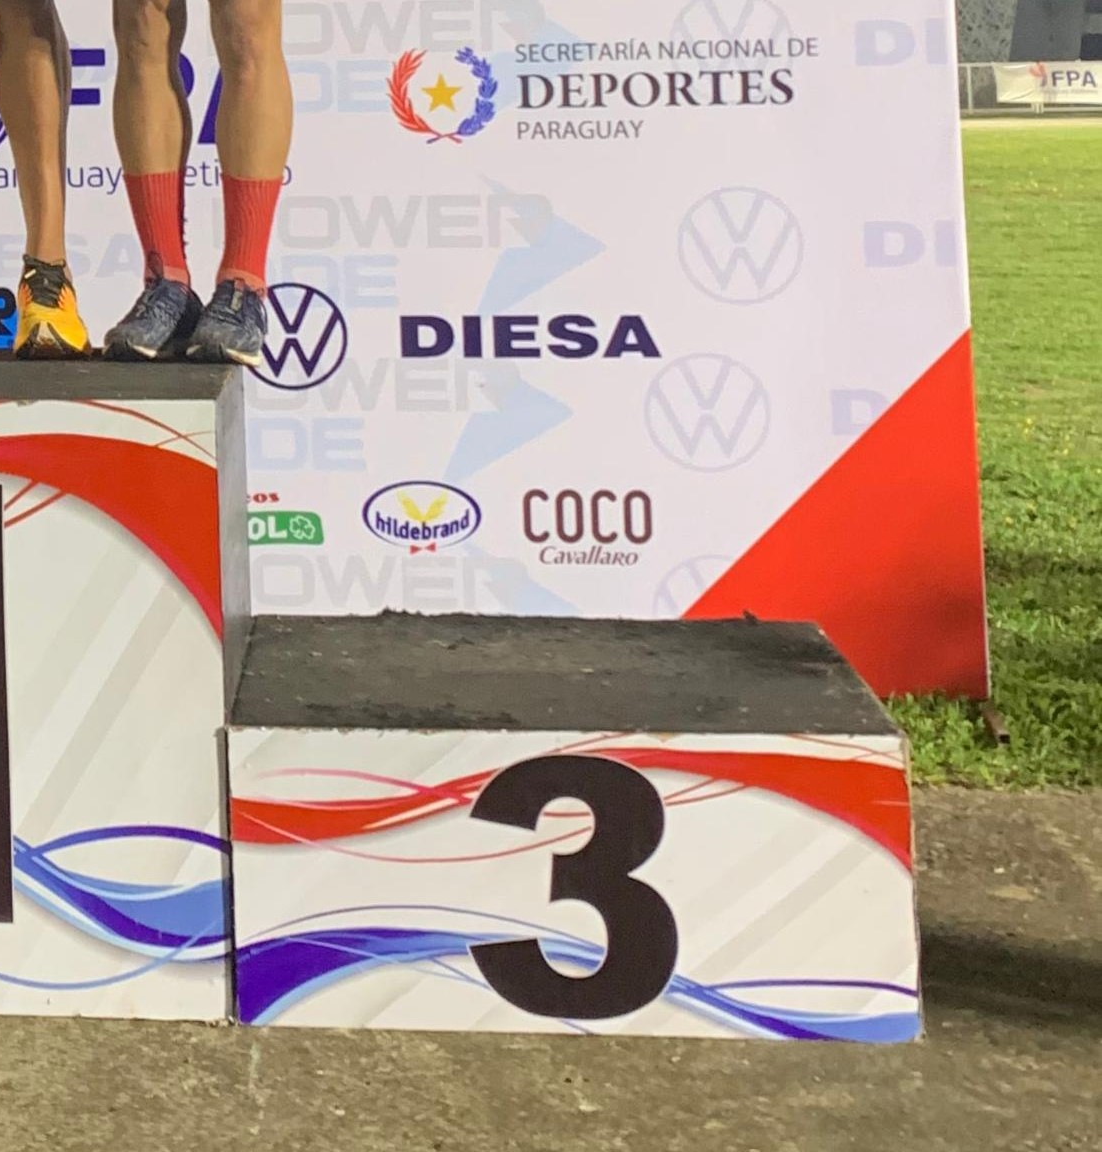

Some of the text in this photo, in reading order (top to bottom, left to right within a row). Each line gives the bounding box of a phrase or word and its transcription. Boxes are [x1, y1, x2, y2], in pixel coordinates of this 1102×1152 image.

[515, 36, 819, 65] SECRETARÍA NACIONAL DE
[516, 67, 795, 110] DEPORTES
[1051, 69, 1097, 88] FPA
[516, 118, 644, 141] PARAGUAY
[399, 314, 663, 359] DIESA
[248, 514, 288, 542] OL
[374, 508, 471, 542] hildebrand
[522, 488, 654, 545] COCO
[469, 755, 679, 1020] 3
